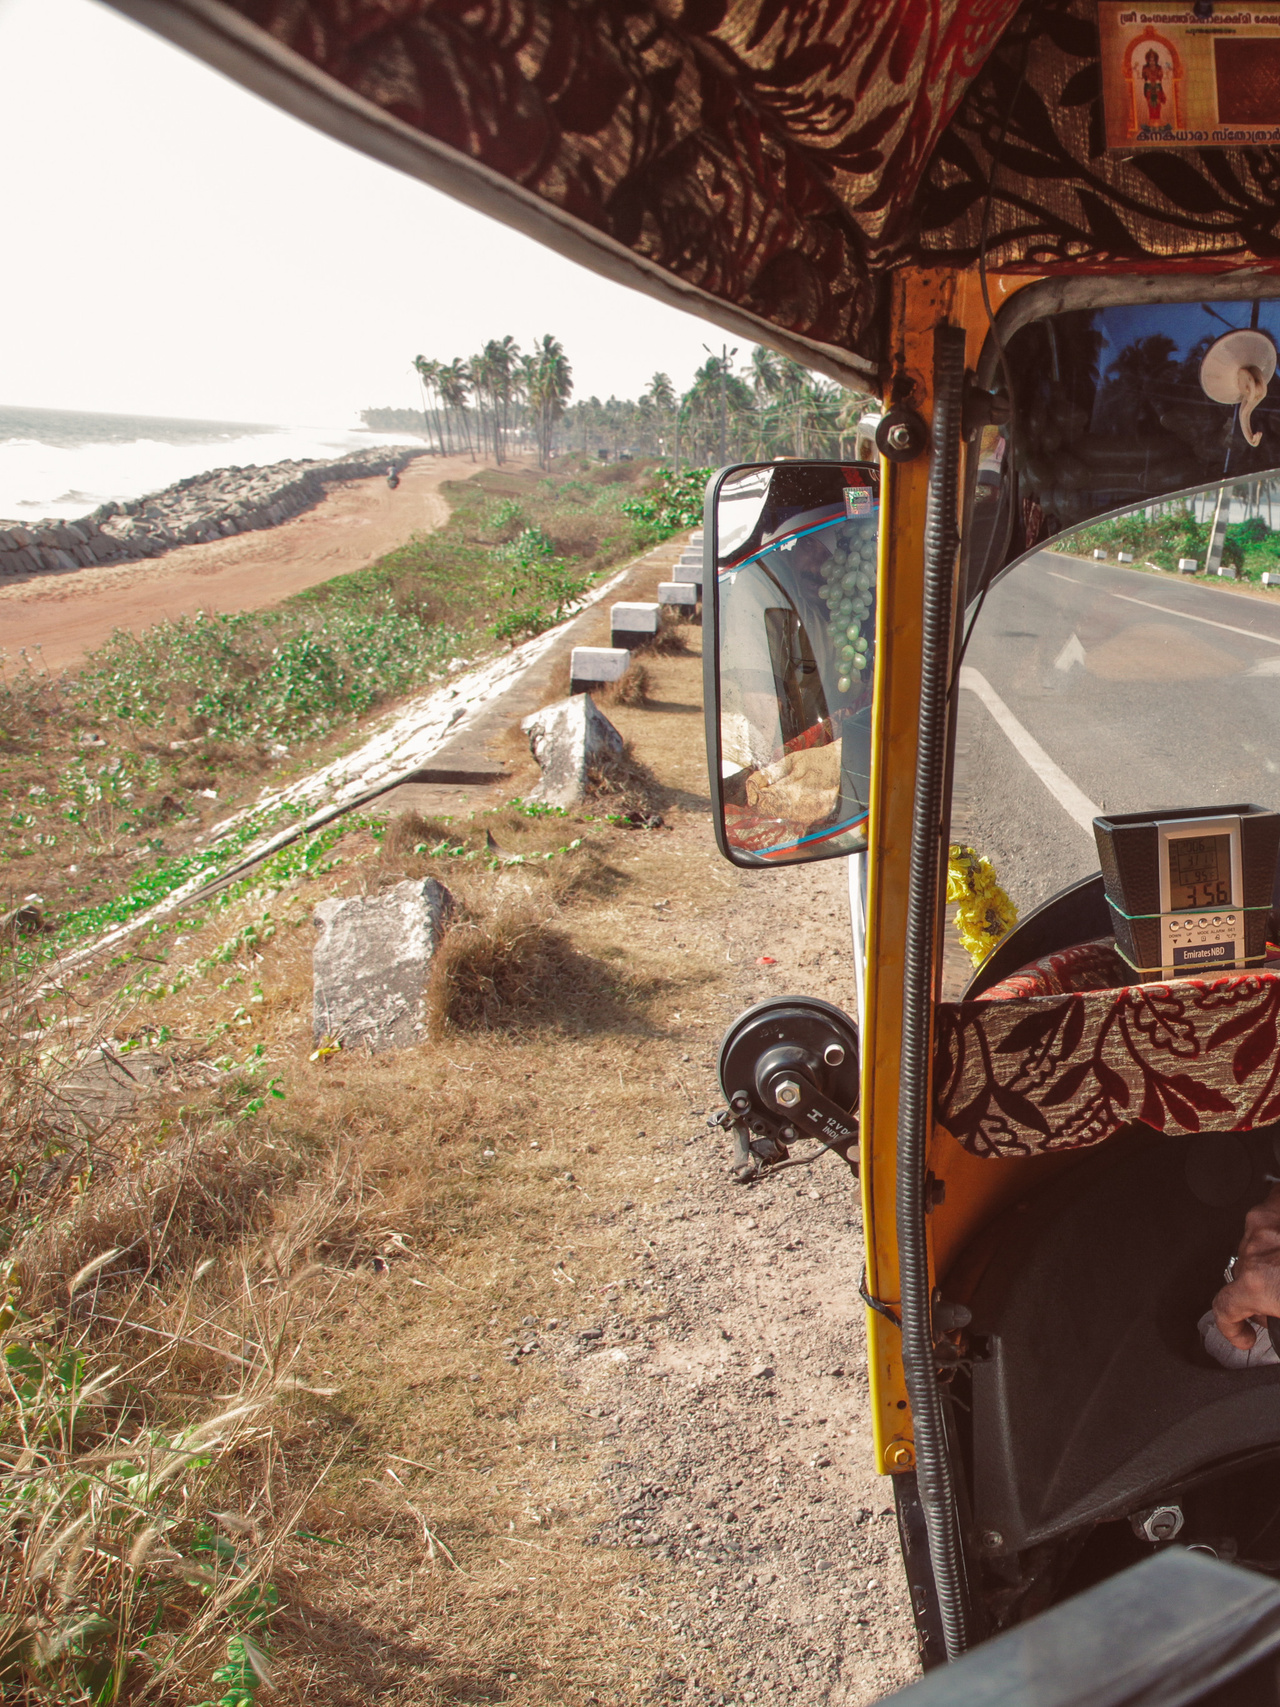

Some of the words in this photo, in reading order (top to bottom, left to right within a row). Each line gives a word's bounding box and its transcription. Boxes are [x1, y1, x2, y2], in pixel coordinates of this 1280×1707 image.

[1183, 949, 1211, 960] Emirates
[1211, 946, 1225, 956] NBD
[822, 1125, 840, 1140] INDI
